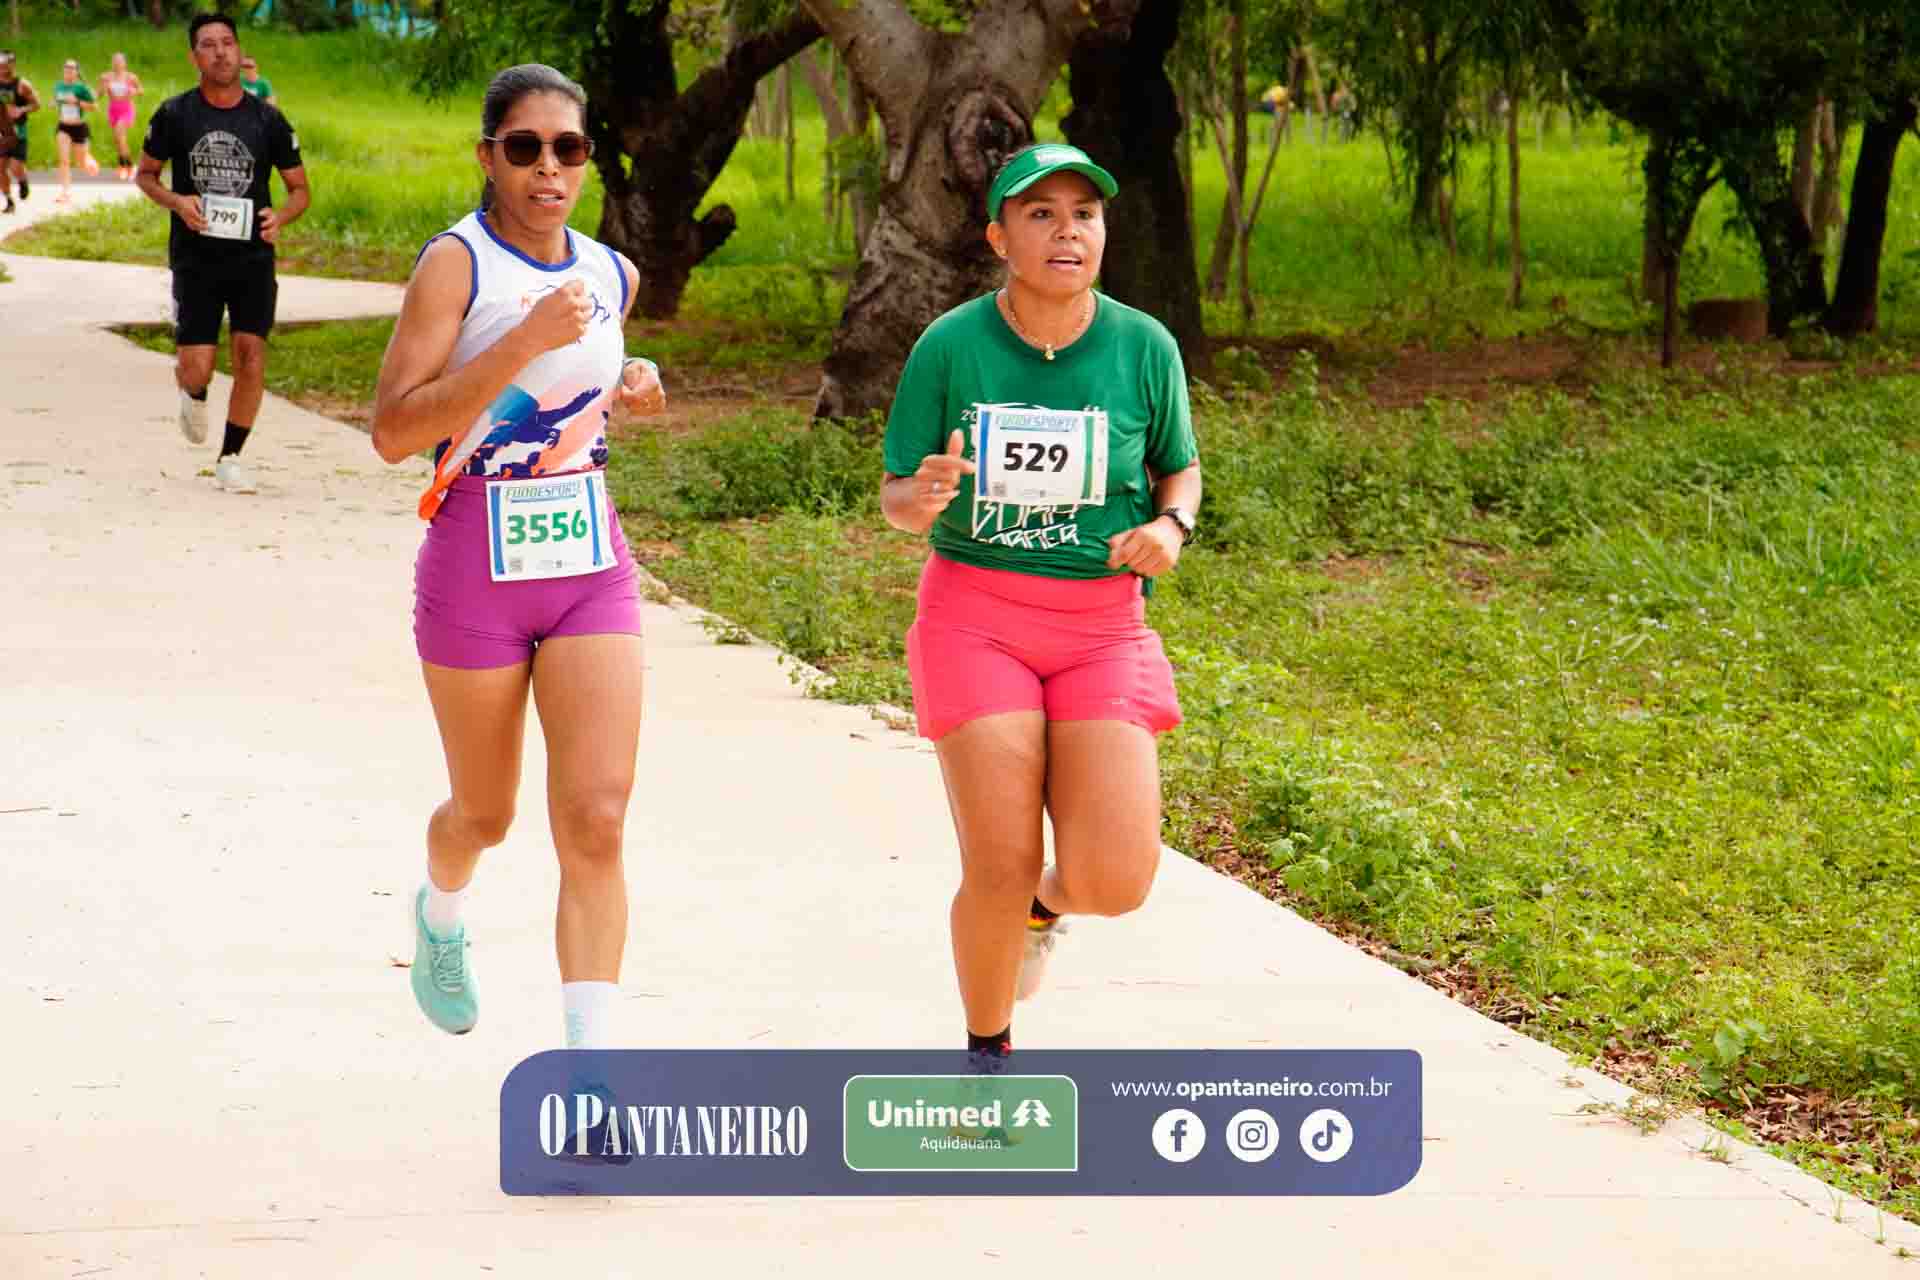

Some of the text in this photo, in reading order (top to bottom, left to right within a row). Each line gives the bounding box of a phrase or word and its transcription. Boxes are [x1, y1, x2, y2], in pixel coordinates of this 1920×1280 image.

[211, 210, 238, 224] 799
[1003, 442, 1069, 473] 529
[506, 509, 588, 545] 3556
